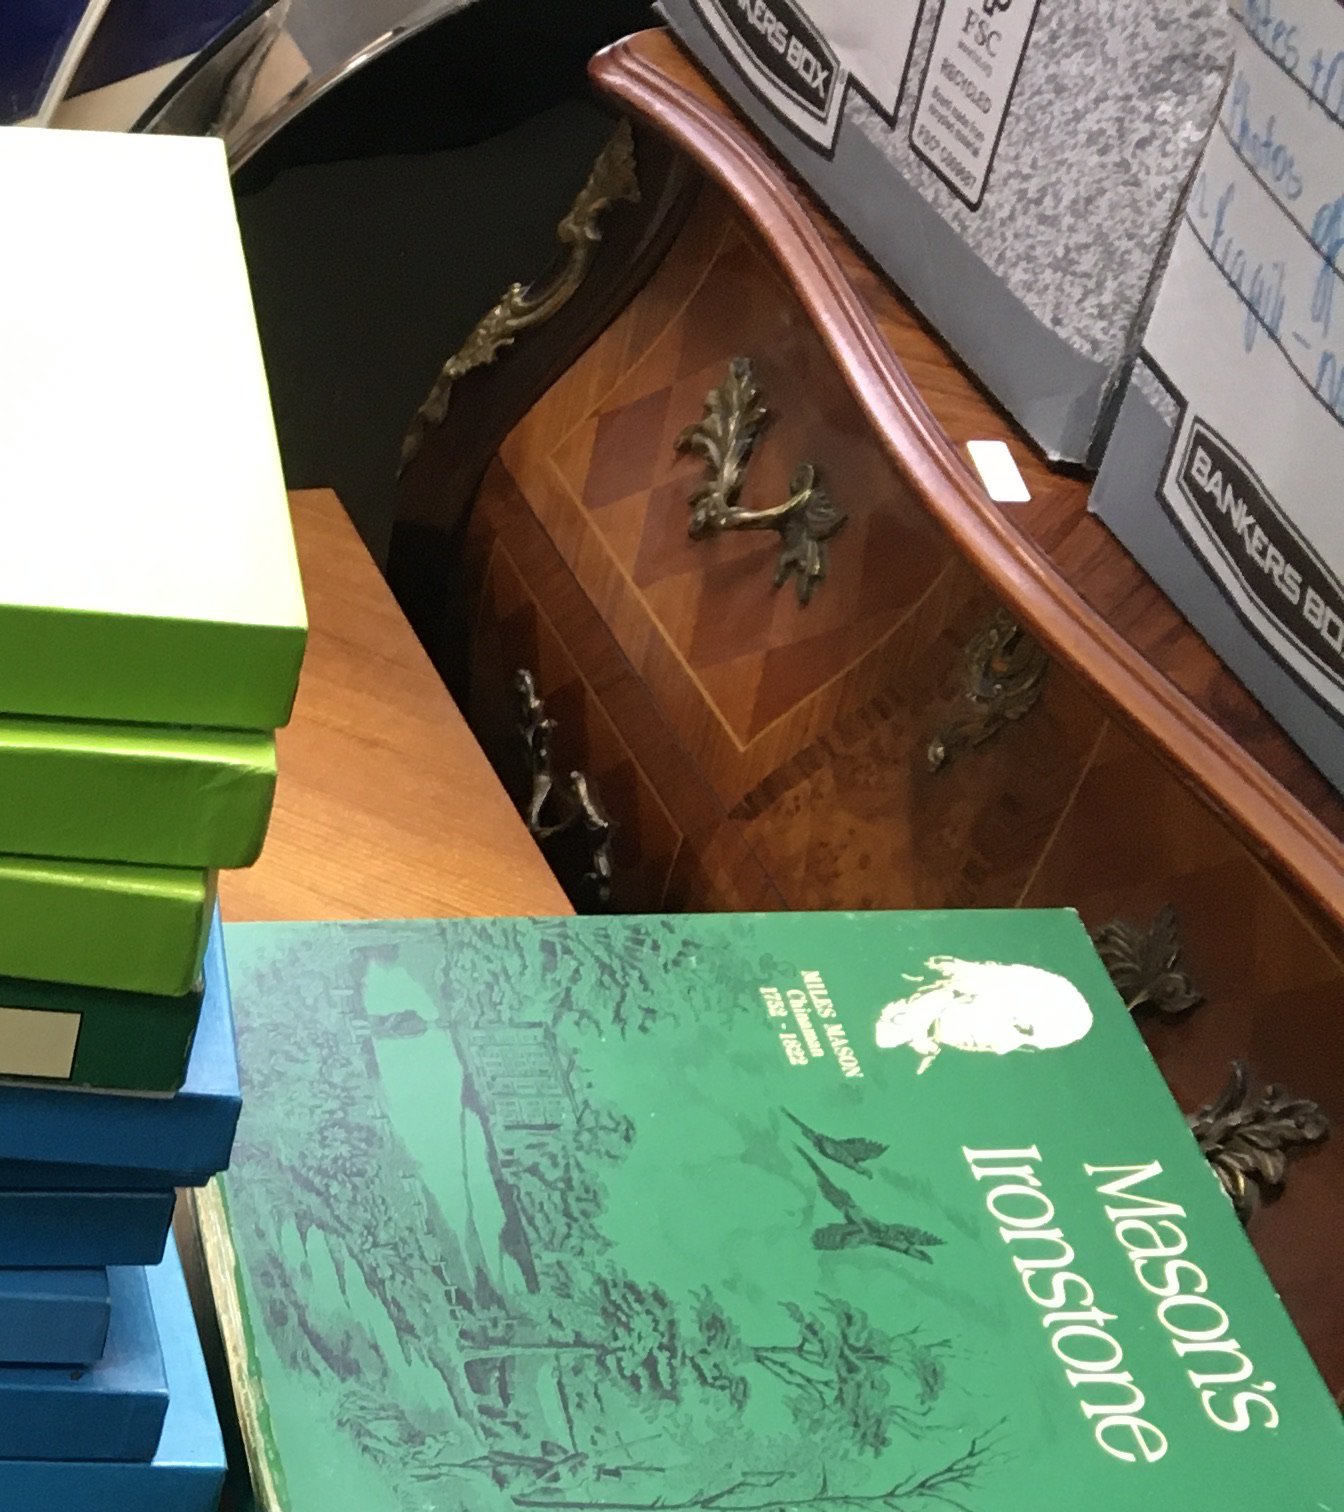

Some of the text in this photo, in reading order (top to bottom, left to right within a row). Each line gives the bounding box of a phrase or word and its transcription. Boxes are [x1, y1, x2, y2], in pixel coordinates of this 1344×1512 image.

[786, 35, 829, 99] BOX
[962, 7, 1002, 58] FSC
[1191, 445, 1303, 605] BANKERS
[1303, 585, 1344, 657] BO
[786, 989, 824, 1057] Chinaman
[801, 970, 864, 1078] MILES MASON
[962, 1144, 1169, 1465] Ironstone
[1082, 1160, 1280, 1433] Mason's
